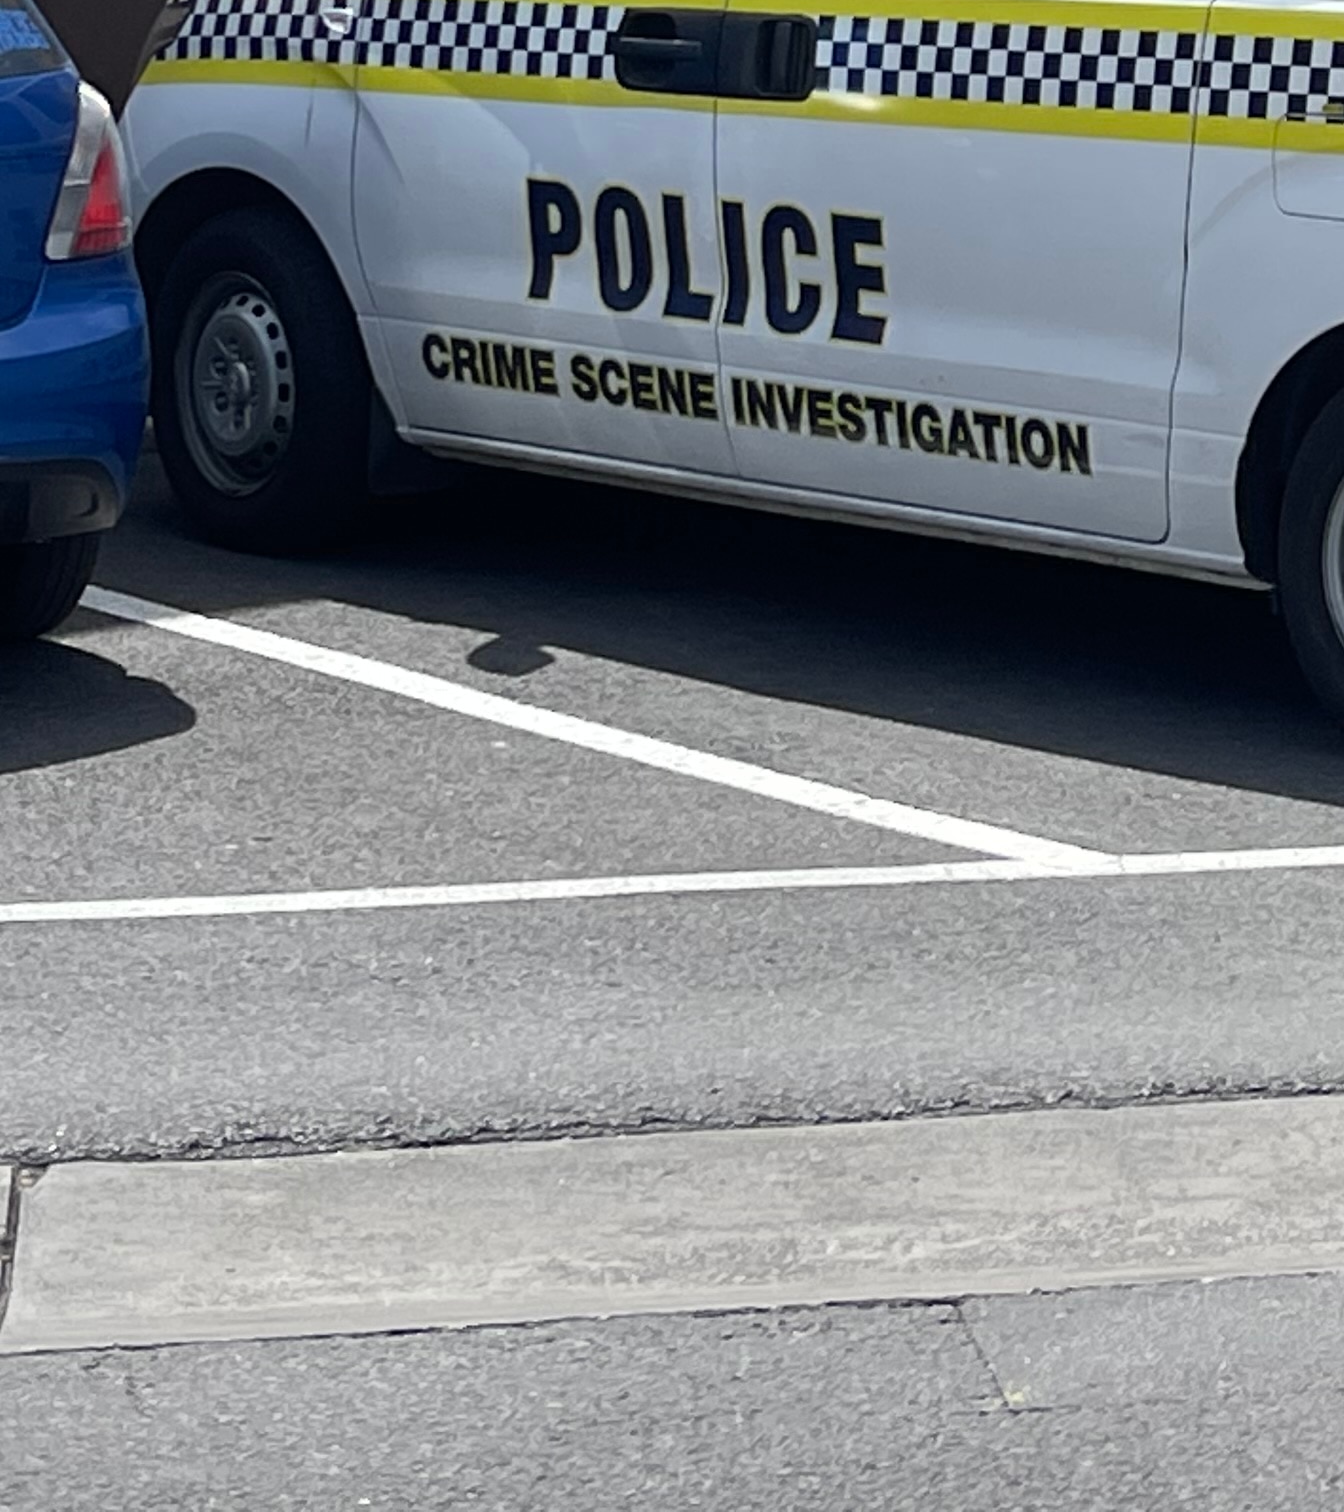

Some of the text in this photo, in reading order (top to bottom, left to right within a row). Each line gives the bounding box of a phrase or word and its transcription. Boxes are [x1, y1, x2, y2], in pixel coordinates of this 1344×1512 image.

[525, 176, 890, 346] POLICE
[421, 332, 1094, 476] CRIME SCENE INVESTIGATION
